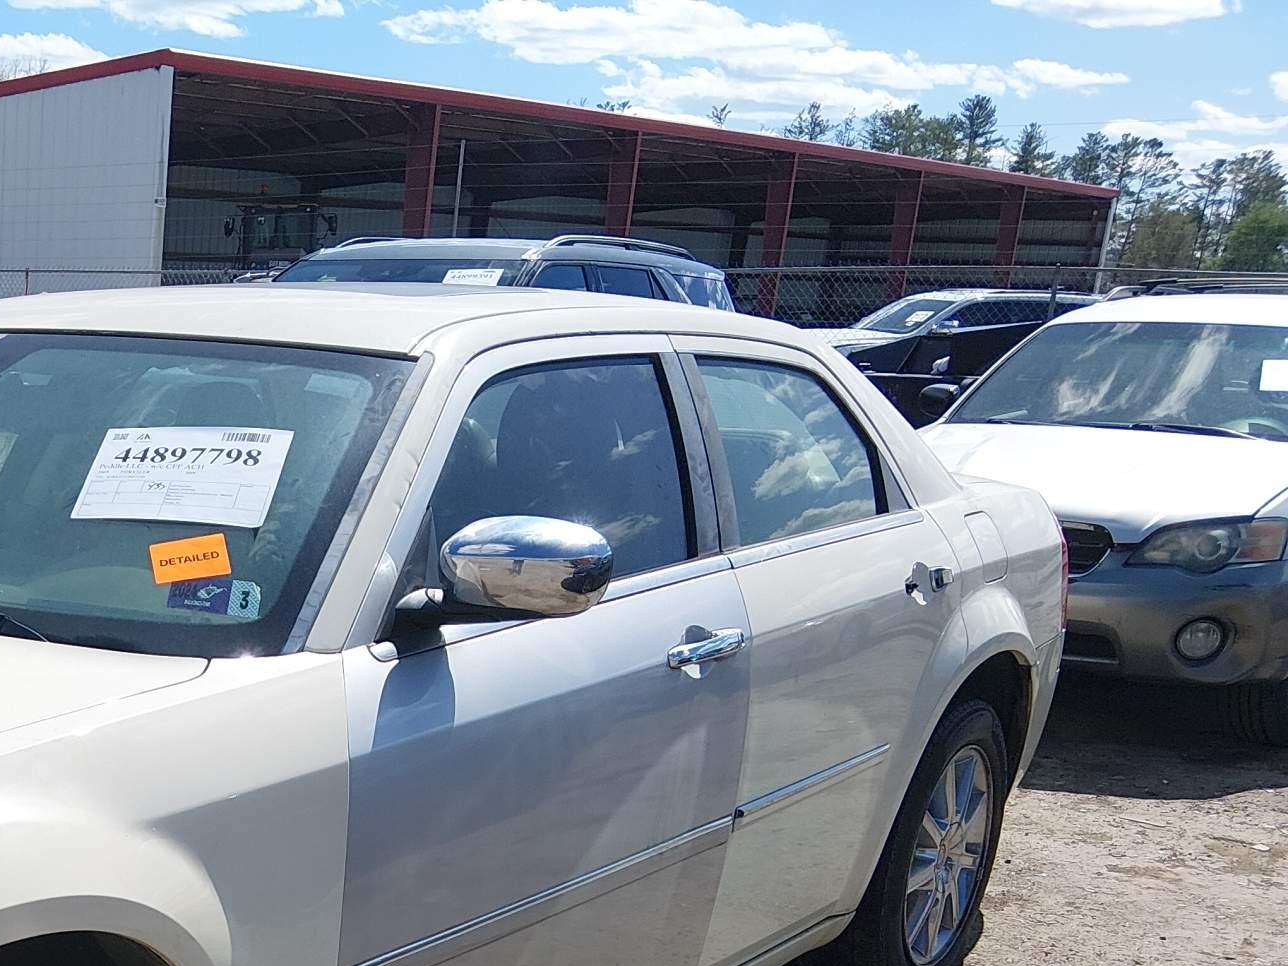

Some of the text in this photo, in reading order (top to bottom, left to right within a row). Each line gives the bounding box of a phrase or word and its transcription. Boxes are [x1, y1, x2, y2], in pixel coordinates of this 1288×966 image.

[114, 446, 262, 466] 44897798
[159, 551, 220, 567] DETAILED
[240, 590, 250, 609] 3
